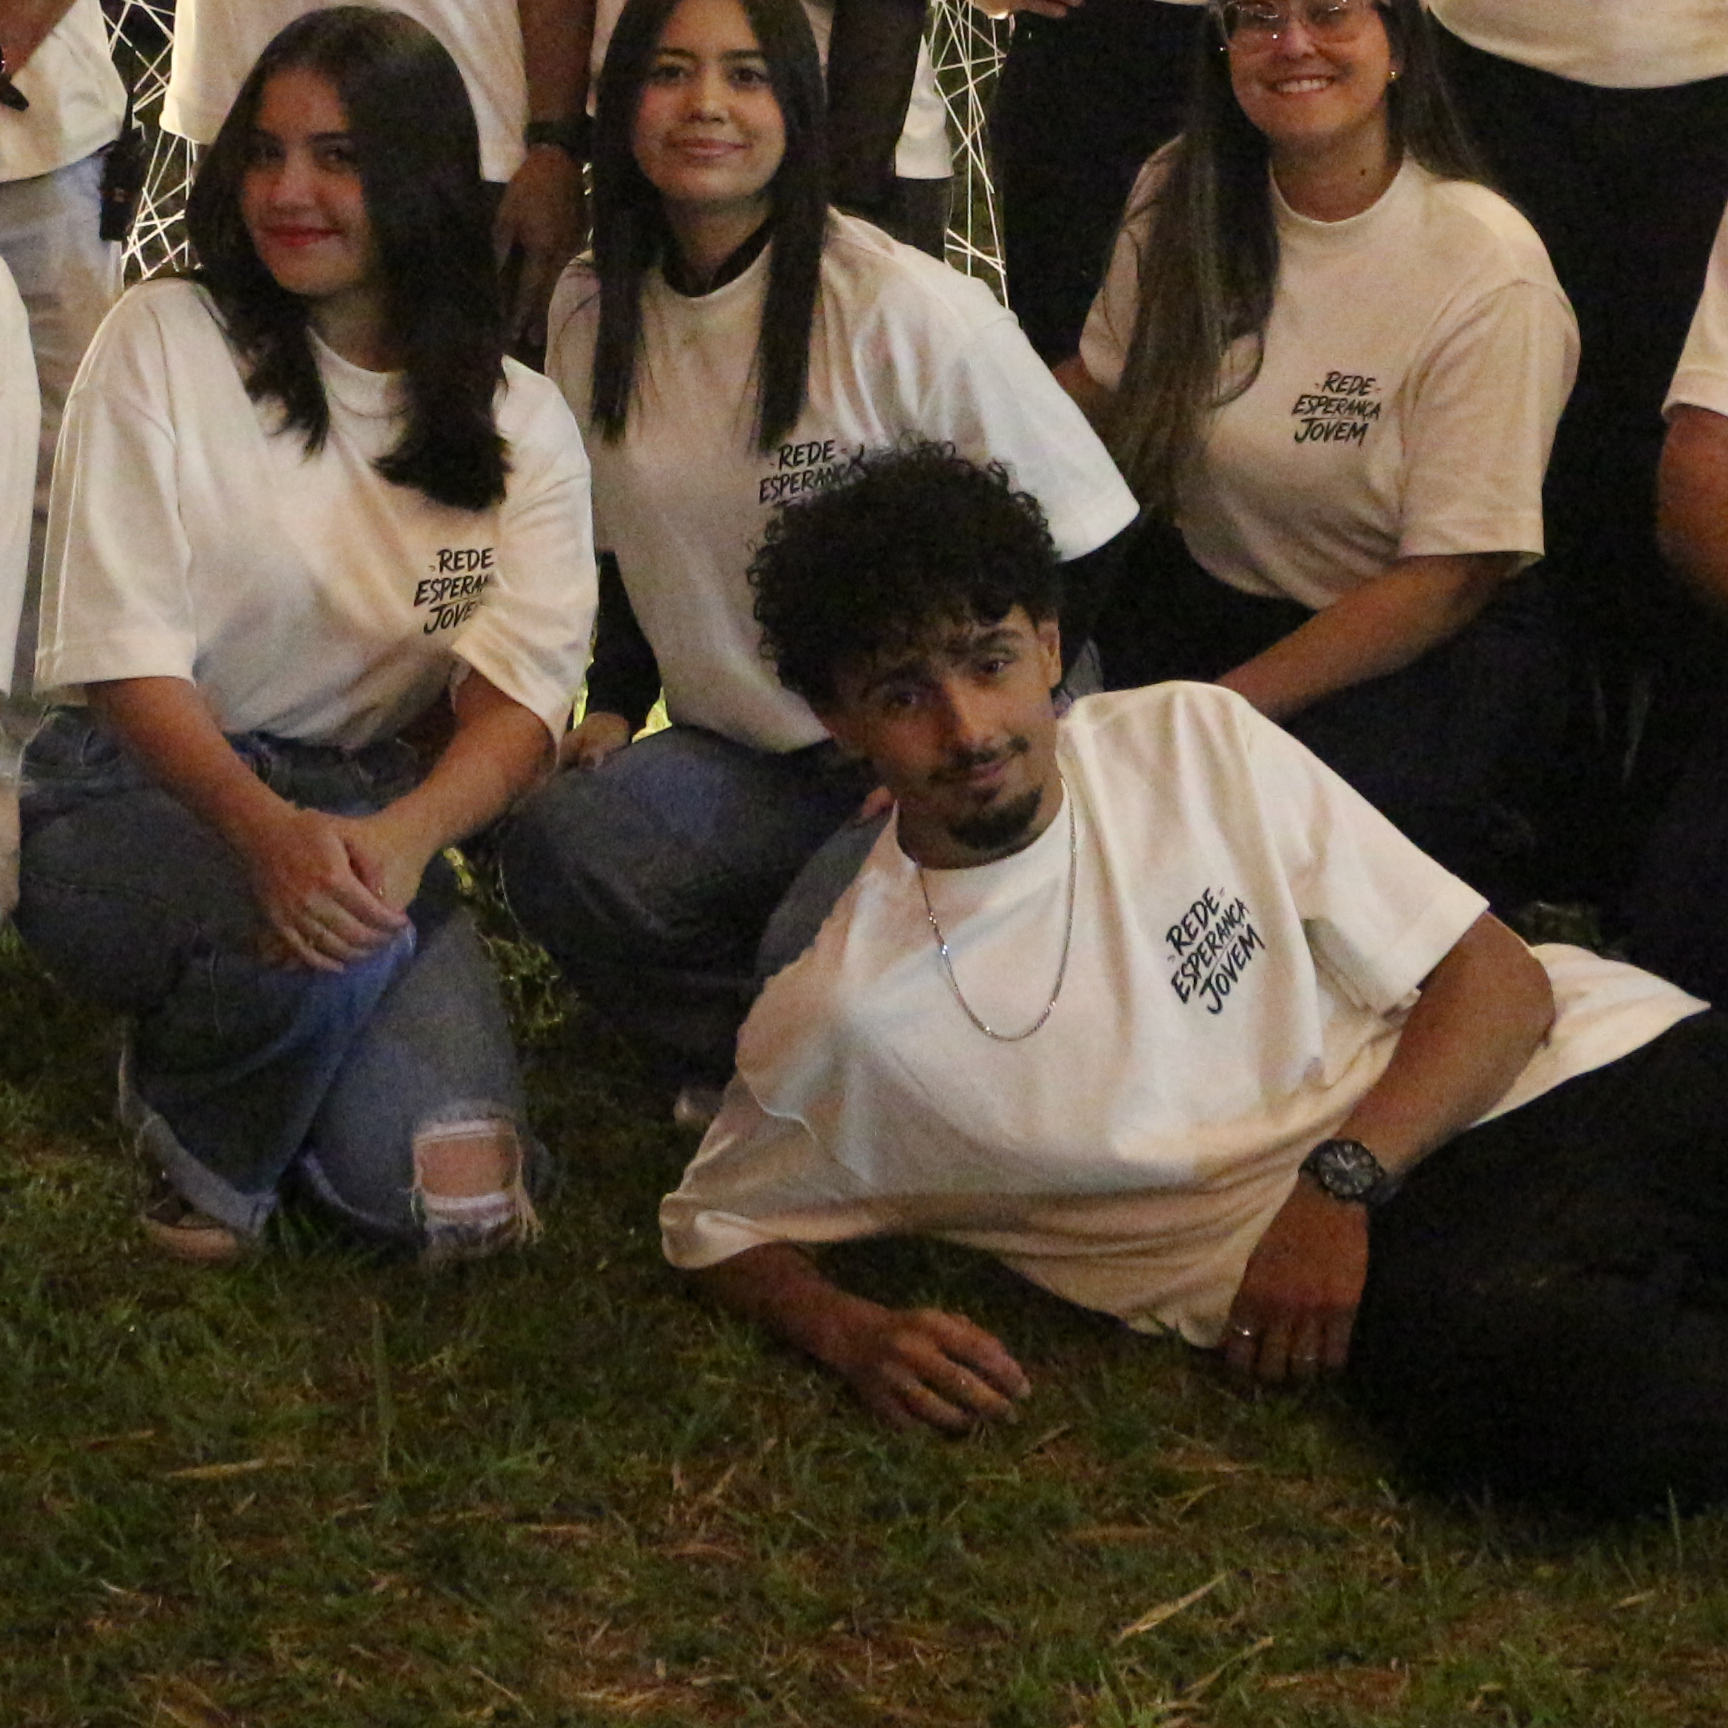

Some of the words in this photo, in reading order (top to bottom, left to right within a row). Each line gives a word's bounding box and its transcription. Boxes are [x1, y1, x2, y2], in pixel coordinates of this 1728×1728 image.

[1321, 371, 1376, 396] REDE
[1292, 394, 1381, 421] ESPERANÇA
[1294, 417, 1369, 447] JOVEM
[778, 439, 835, 470] REDE
[436, 547, 494, 573] REDE
[1166, 887, 1220, 956] REDE
[1171, 897, 1250, 1004] ESPERANÇA
[1199, 923, 1266, 1015] JOVEM
